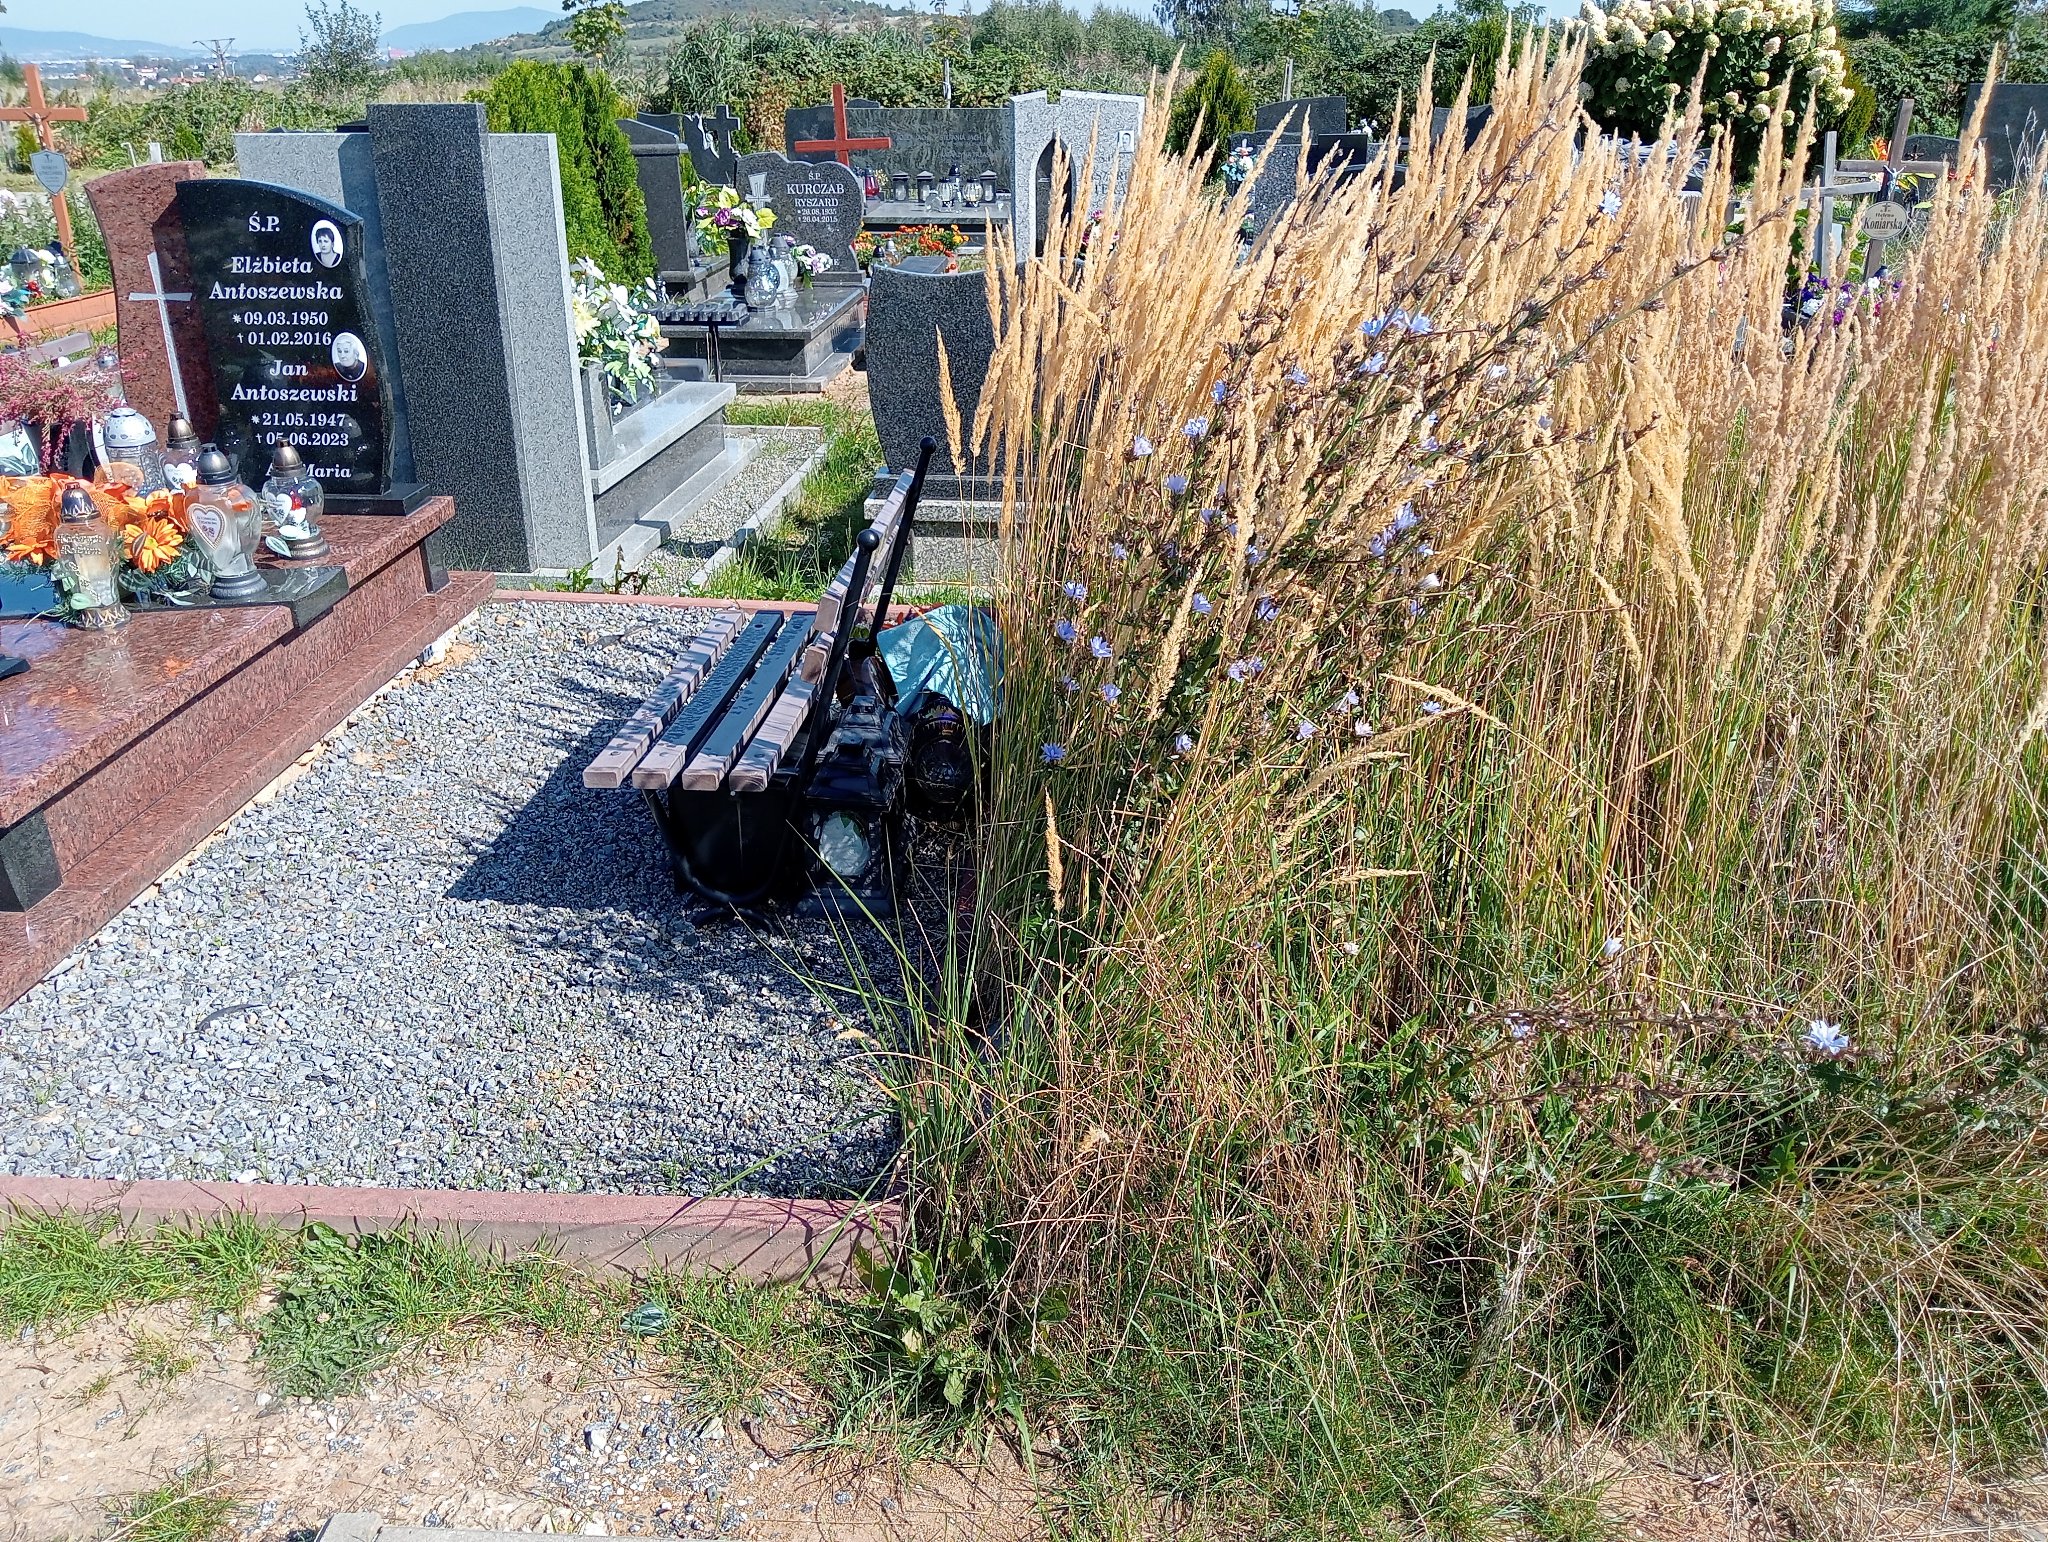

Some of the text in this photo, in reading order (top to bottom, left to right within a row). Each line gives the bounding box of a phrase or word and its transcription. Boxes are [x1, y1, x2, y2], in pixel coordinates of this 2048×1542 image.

[786, 183, 845, 195] KURCZAB
[794, 198, 839, 207] RYSZARD
[248, 211, 281, 232] Ś.P.
[1863, 217, 1903, 230] Koniarska
[230, 256, 314, 274] Elżbieta
[208, 280, 344, 300] Antoszewska
[269, 359, 309, 376] Jan
[230, 382, 358, 401] Antoszewski
